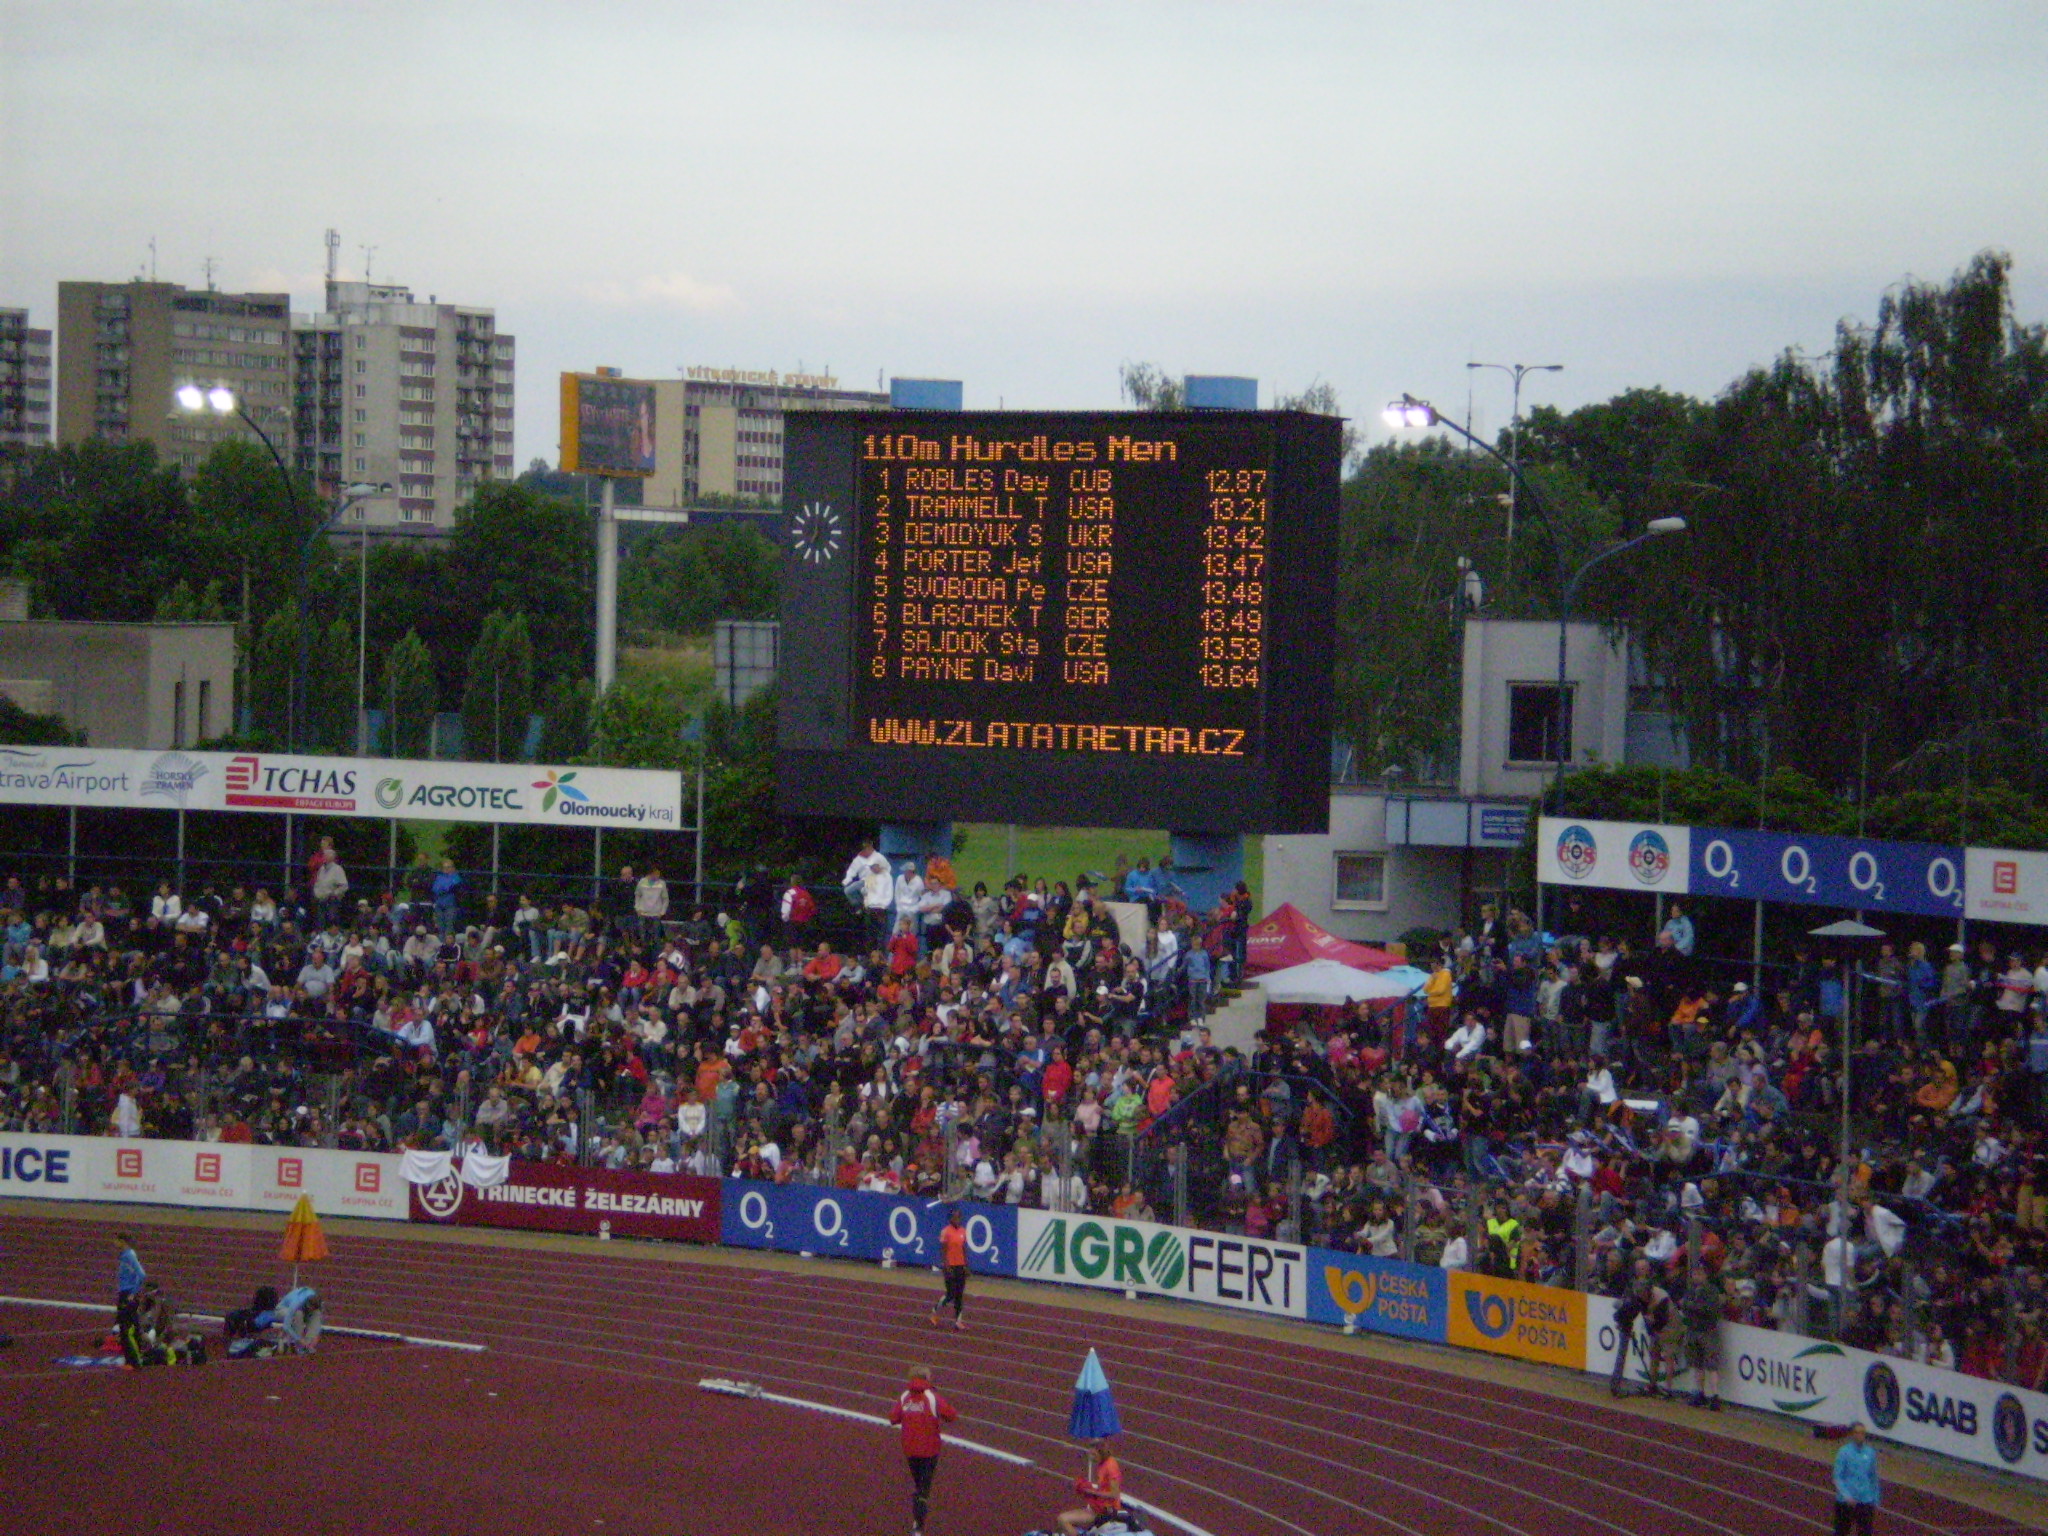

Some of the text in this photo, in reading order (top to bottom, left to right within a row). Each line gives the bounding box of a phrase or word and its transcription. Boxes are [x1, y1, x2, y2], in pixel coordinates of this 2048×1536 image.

[862, 434, 1177, 461] 110m Hurdles Men
[880, 468, 1267, 492] 1 ROBLES Day CUB 12.87
[876, 495, 1267, 522] 2 TRAMMELL T USA 13.21
[875, 523, 1265, 550] 3 DEMIDYUK S UKR 13.42
[875, 550, 1264, 577] 4 PORTER Jef USA 13.47
[874, 576, 888, 598] 5
[903, 577, 1006, 600] SVOBODA
[1016, 578, 1046, 600] Pe
[1066, 580, 1107, 602] CZE
[873, 603, 1262, 632] 6 BLASCHEK T GER 13.49
[873, 629, 1261, 660] 7 SAJDOK Sta CZE 13.53
[872, 657, 1259, 688] 8 PAYNE Davi USA 13.64
[870, 718, 1245, 755] WWW.ZLATATRETRA.CZ
[56, 772, 129, 794] Airport
[264, 767, 357, 795] TCHAS
[408, 785, 523, 809] AGROTEC
[560, 801, 673, 823] Olomoucký kraj
[1705, 840, 1739, 887] O2
[1781, 846, 1816, 893] O2
[1849, 852, 1884, 899] O2
[1927, 858, 1963, 907] O2
[2, 1147, 70, 1184] ICE
[585, 1188, 704, 1217] ŽELEZÁRNY
[740, 1192, 774, 1238] O2
[814, 1199, 848, 1246] O2
[889, 1206, 924, 1254] O2
[966, 1215, 999, 1263] O2
[1378, 1298, 1428, 1324] POŠTA
[1518, 1324, 1567, 1350] POŠTA
[1738, 1354, 1817, 1396] OSINEK
[1905, 1386, 1977, 1435] SAAB
